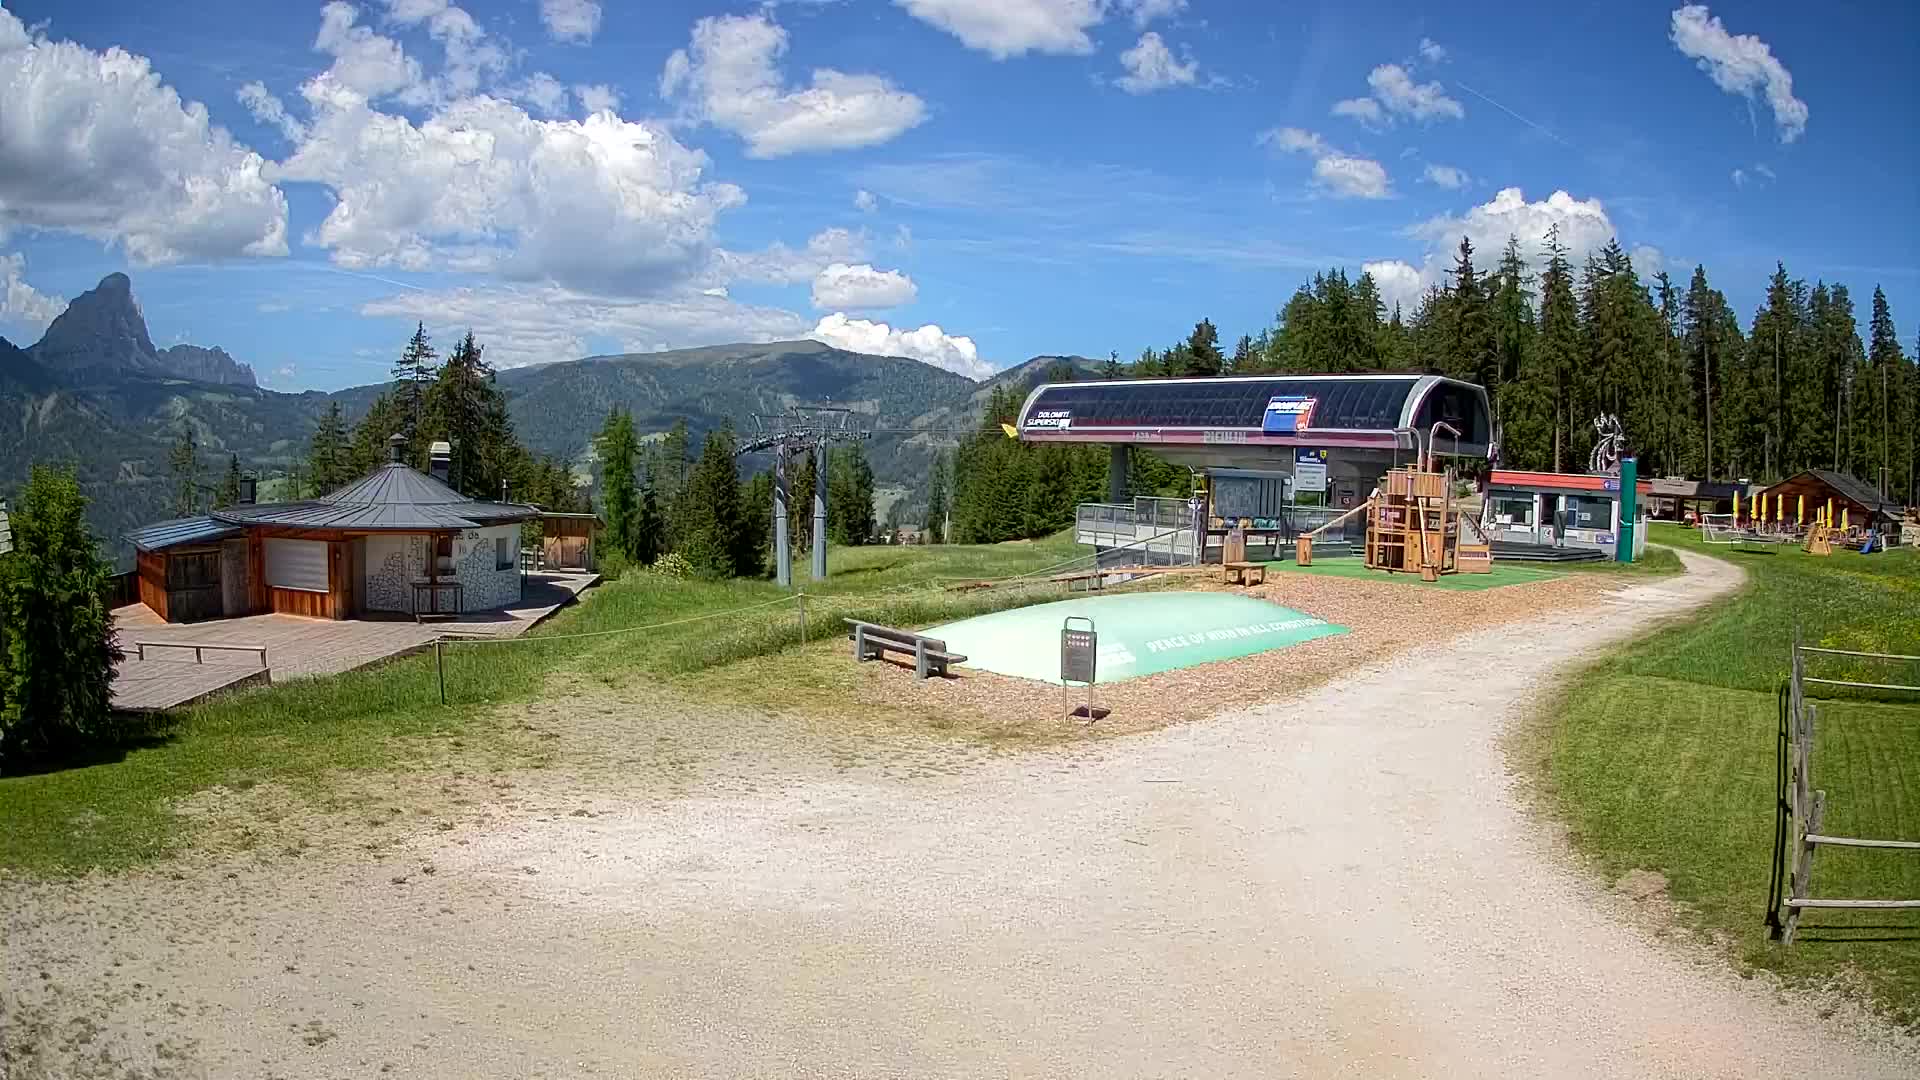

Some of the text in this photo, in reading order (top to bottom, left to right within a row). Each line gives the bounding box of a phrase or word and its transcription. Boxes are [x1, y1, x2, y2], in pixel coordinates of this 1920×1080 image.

[1027, 418, 1060, 426] SUPERSKI
[1146, 635, 1189, 652] PEACE
[1188, 633, 1206, 645] OF
[1249, 623, 1271, 634] ALL
